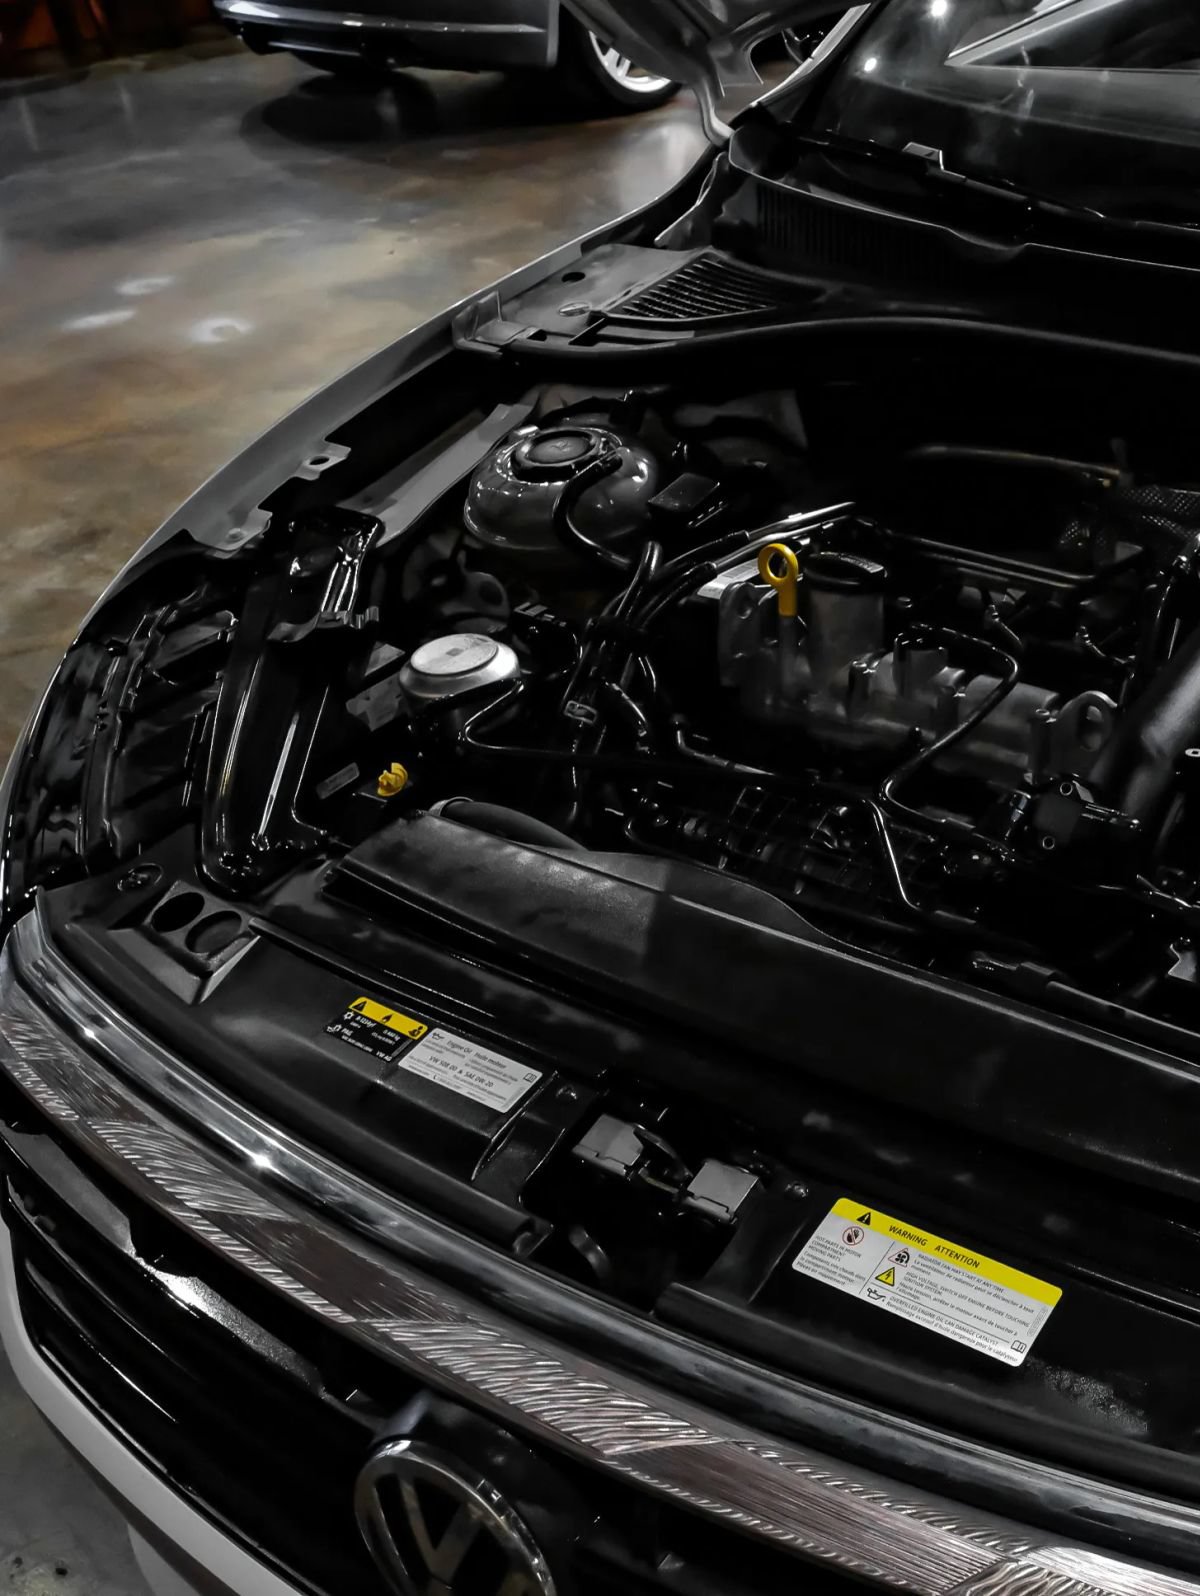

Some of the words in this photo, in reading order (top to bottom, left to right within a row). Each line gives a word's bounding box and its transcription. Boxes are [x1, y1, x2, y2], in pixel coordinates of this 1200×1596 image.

[446, 1040, 465, 1051] Engine
[474, 1052, 489, 1060] Huile
[487, 1058, 507, 1069] moteur
[464, 1071, 476, 1079] SAE
[808, 1245, 827, 1255] MOVING
[826, 1253, 841, 1262] PARTS
[825, 1240, 839, 1248] PARTS
[888, 1225, 928, 1246] WARNING
[934, 1244, 981, 1268] ATTENTION
[903, 1276, 924, 1288] IGNITION
[917, 1254, 942, 1267] RADIATOR
[960, 1272, 977, 1281] START
[992, 1285, 1004, 1293] TIME
[890, 1296, 918, 1311] OVERFILLED
[917, 1308, 935, 1319] ENGINE
[955, 1324, 976, 1336] DAMAGE
[975, 1333, 999, 1346] CATALYST
[940, 1286, 958, 1296] SWITCH
[968, 1298, 985, 1308] ENGINE
[985, 1306, 1004, 1316] BEFORE
[1005, 1314, 1030, 1327] TOUCHING
